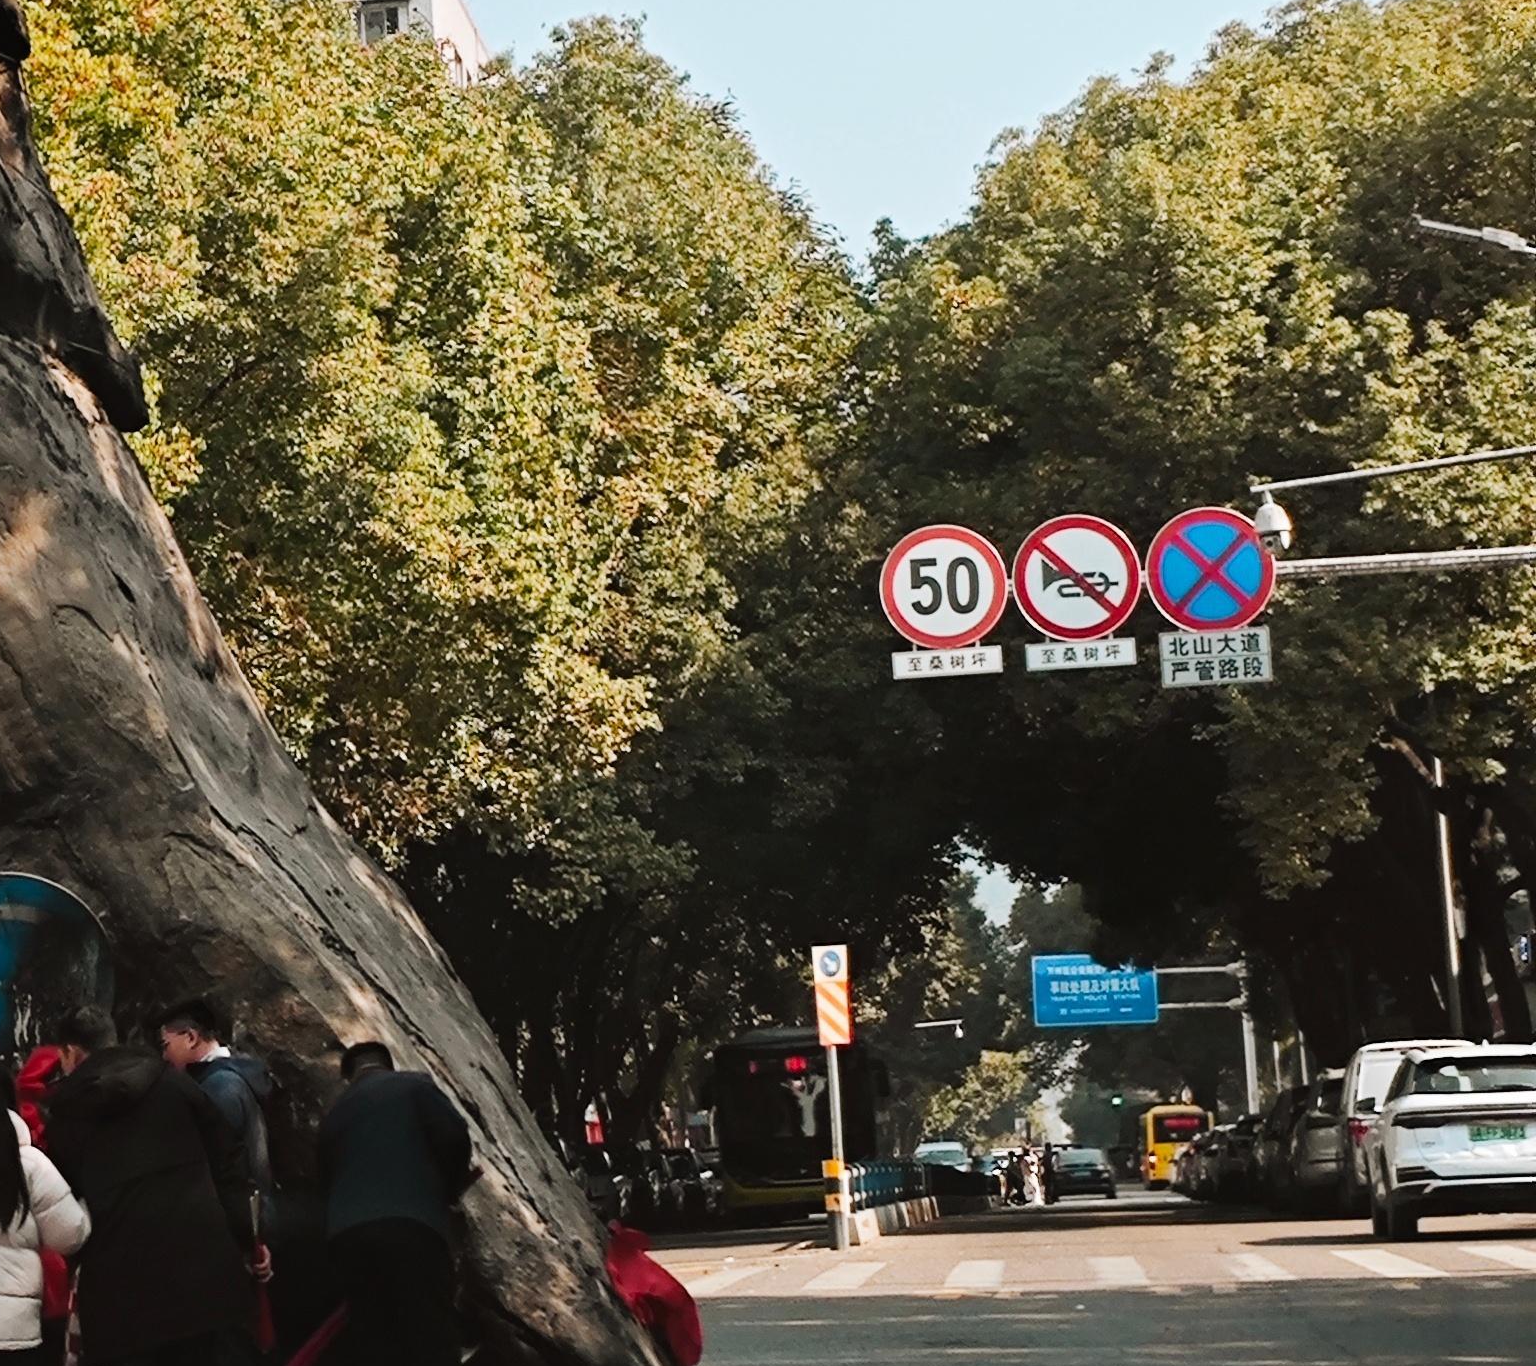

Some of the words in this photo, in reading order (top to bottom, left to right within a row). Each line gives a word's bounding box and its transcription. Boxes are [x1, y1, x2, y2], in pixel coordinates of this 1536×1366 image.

[910, 556, 979, 615] 50
[1041, 644, 1121, 664] 至桑树坪
[1169, 632, 1261, 656] 北山大道
[907, 652, 987, 672] 至桑树坪
[1171, 656, 1263, 682] 严管路段
